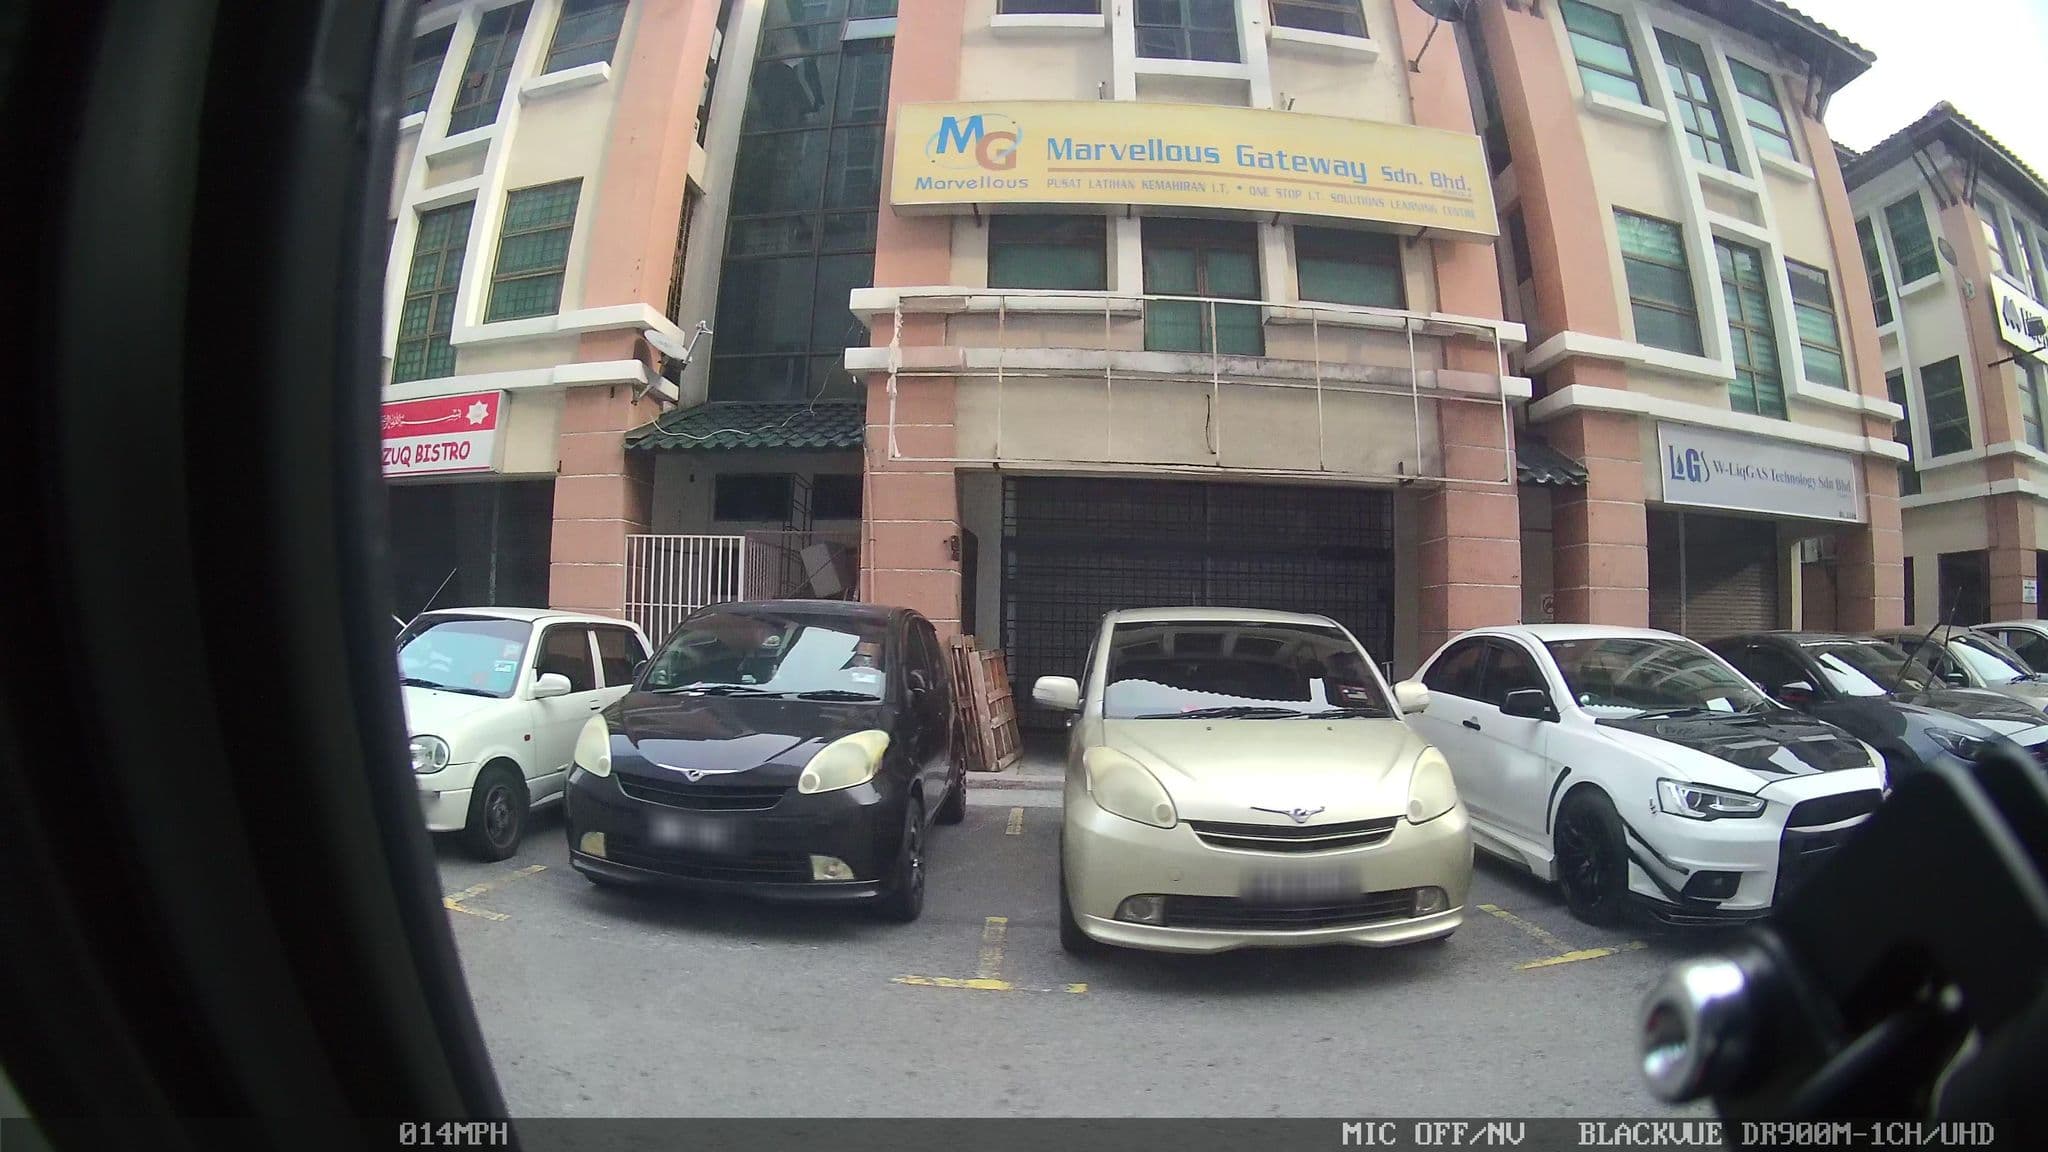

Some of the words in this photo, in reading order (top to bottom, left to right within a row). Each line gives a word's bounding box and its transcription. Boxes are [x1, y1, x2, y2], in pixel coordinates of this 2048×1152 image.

[936, 114, 1017, 171] MG
[1046, 137, 1220, 164] Marvellous
[1236, 144, 1368, 184] Gateway
[1381, 165, 1423, 185] Sdn.
[1430, 170, 1472, 192] Bhd.
[915, 175, 1029, 191] Marvellous
[1047, 177, 1081, 189] PUSAT
[1088, 178, 1136, 190] LATIHAN
[1142, 180, 1207, 192] KEMAHIRAN
[1249, 186, 1269, 198] ONE
[1275, 188, 1302, 201] STOP
[1330, 192, 1385, 208] SOLUTIONS
[415, 441, 471, 463] BISTRO
[1713, 459, 1769, 480] W-LiqGAS
[1771, 469, 1817, 489] Technology
[1819, 476, 1834, 490] Sdn
